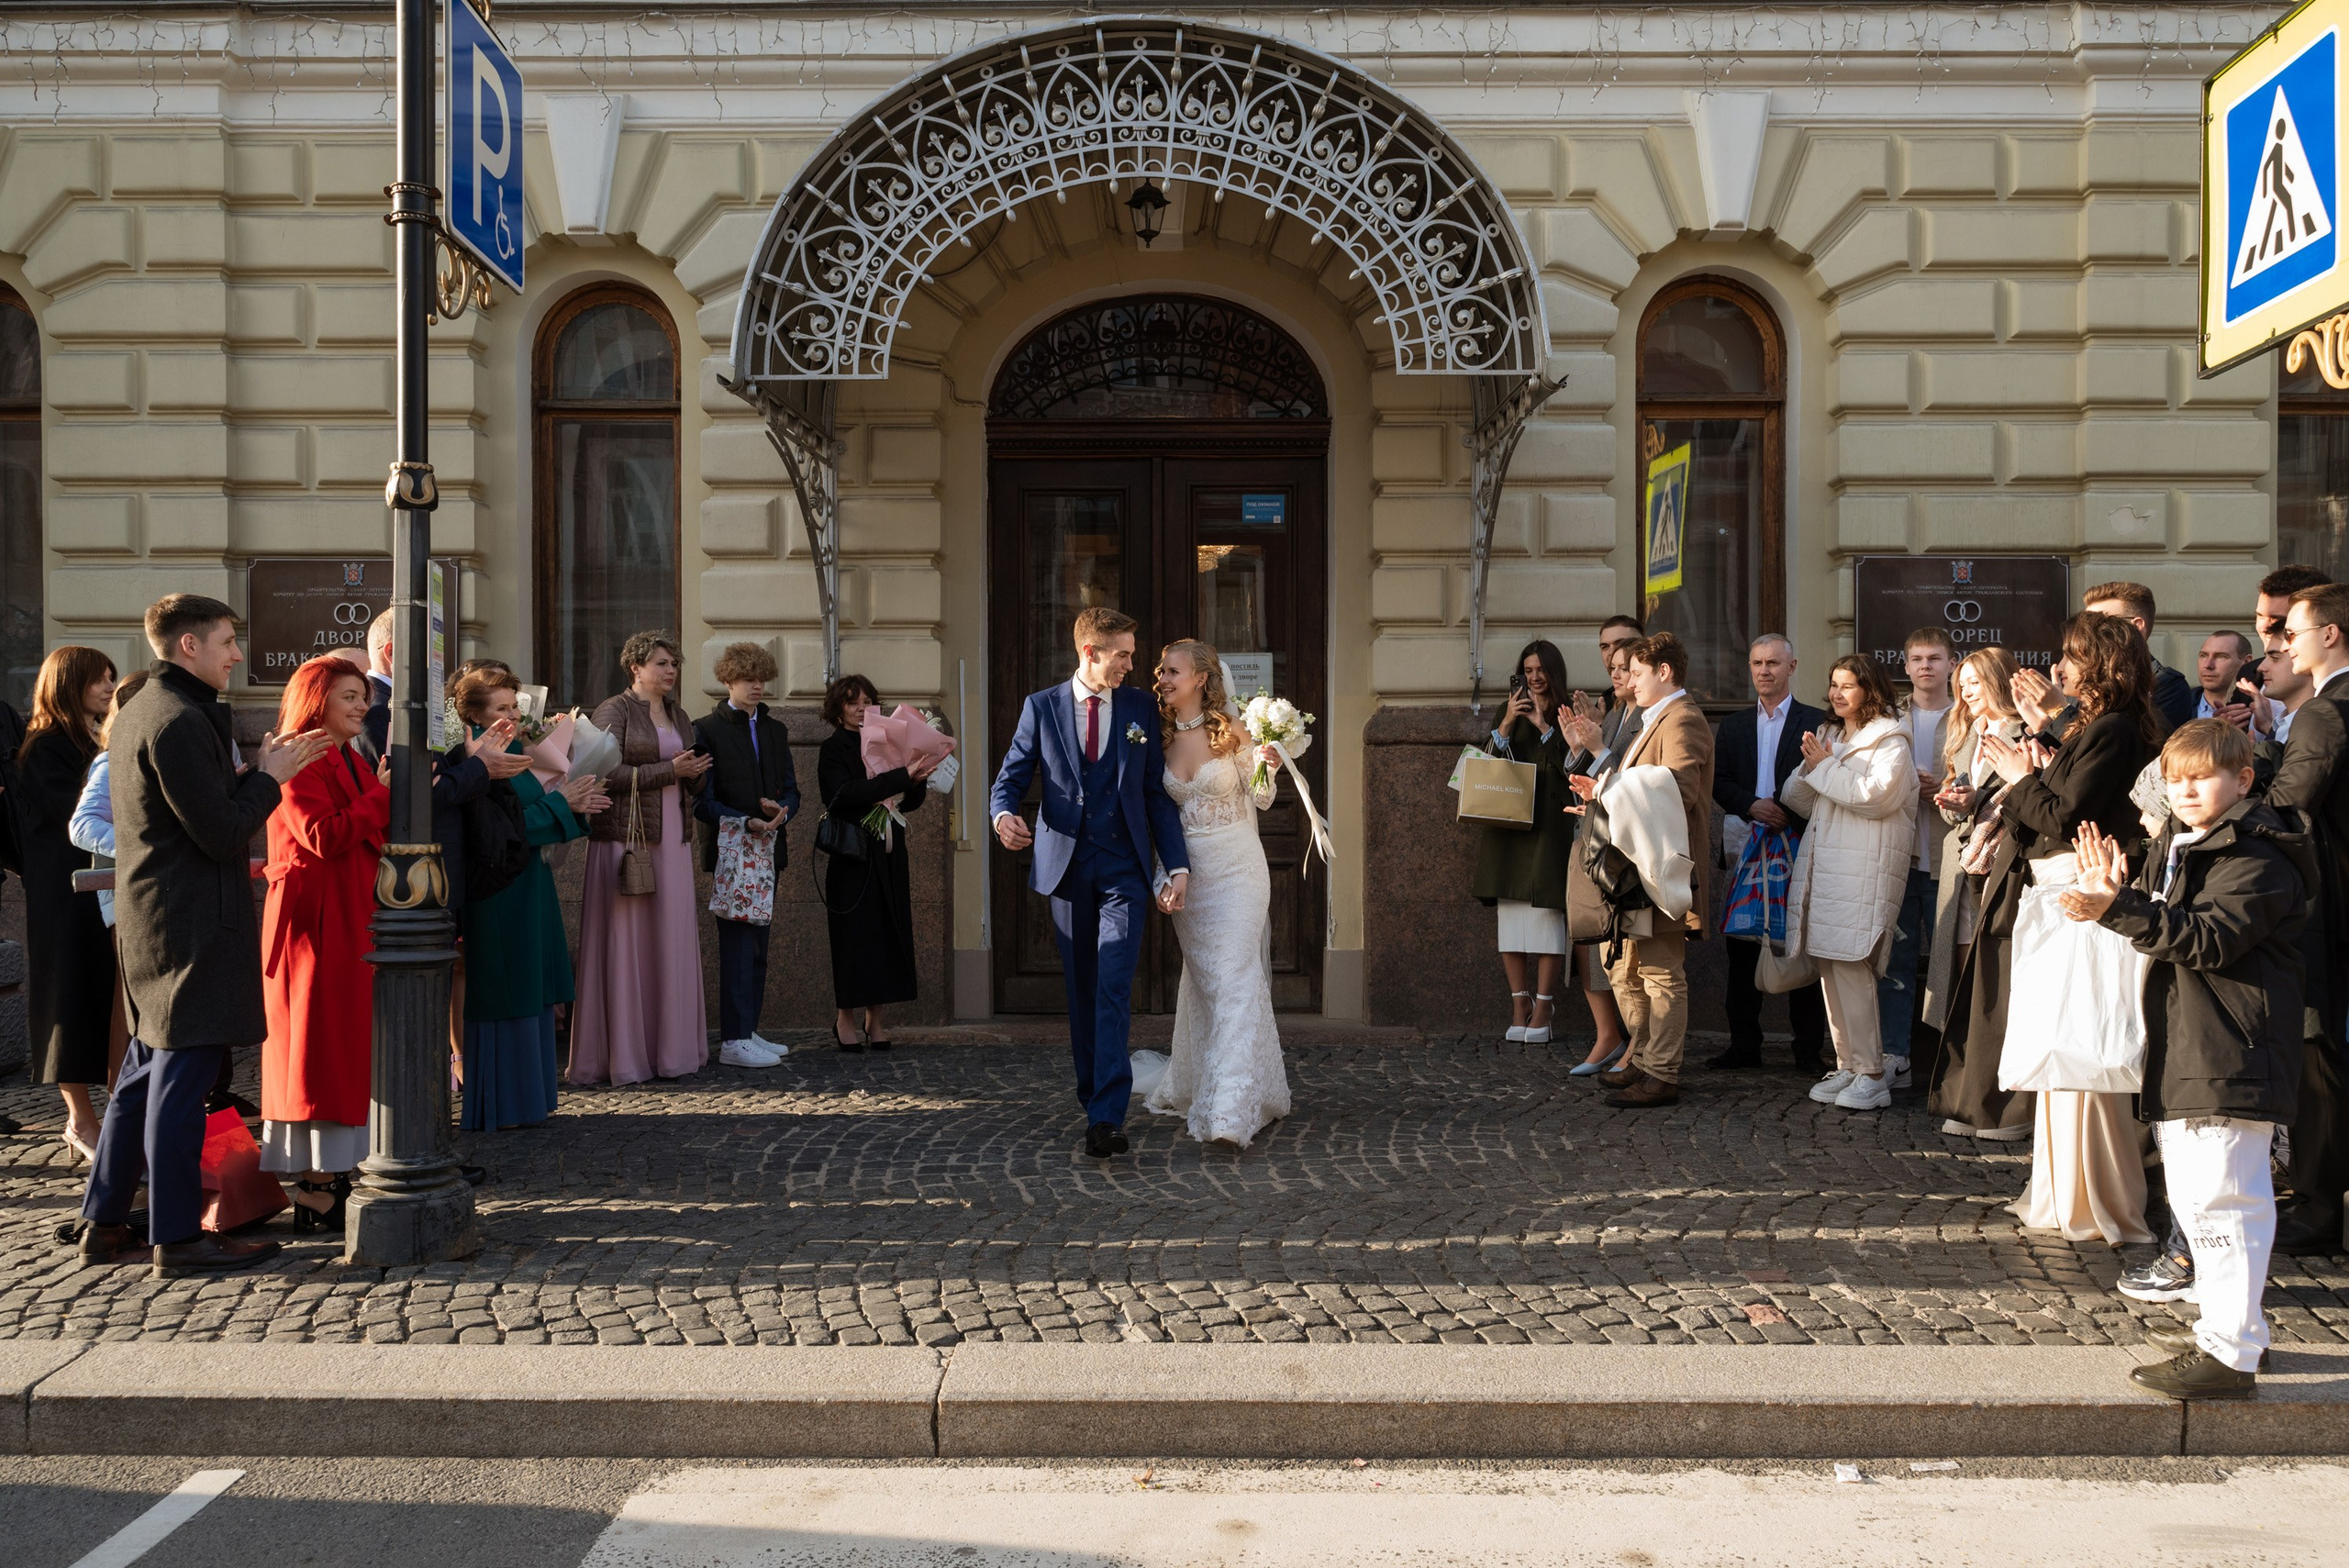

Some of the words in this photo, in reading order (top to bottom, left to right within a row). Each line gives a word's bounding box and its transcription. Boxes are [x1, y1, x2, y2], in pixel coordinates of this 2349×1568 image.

[473, 41, 511, 226] P
[313, 630, 365, 647] ДВОР
[1943, 628, 2002, 644] ОРЕЦ
[1475, 784, 1504, 792] MICHAEL
[1505, 786, 1523, 795] KORS
